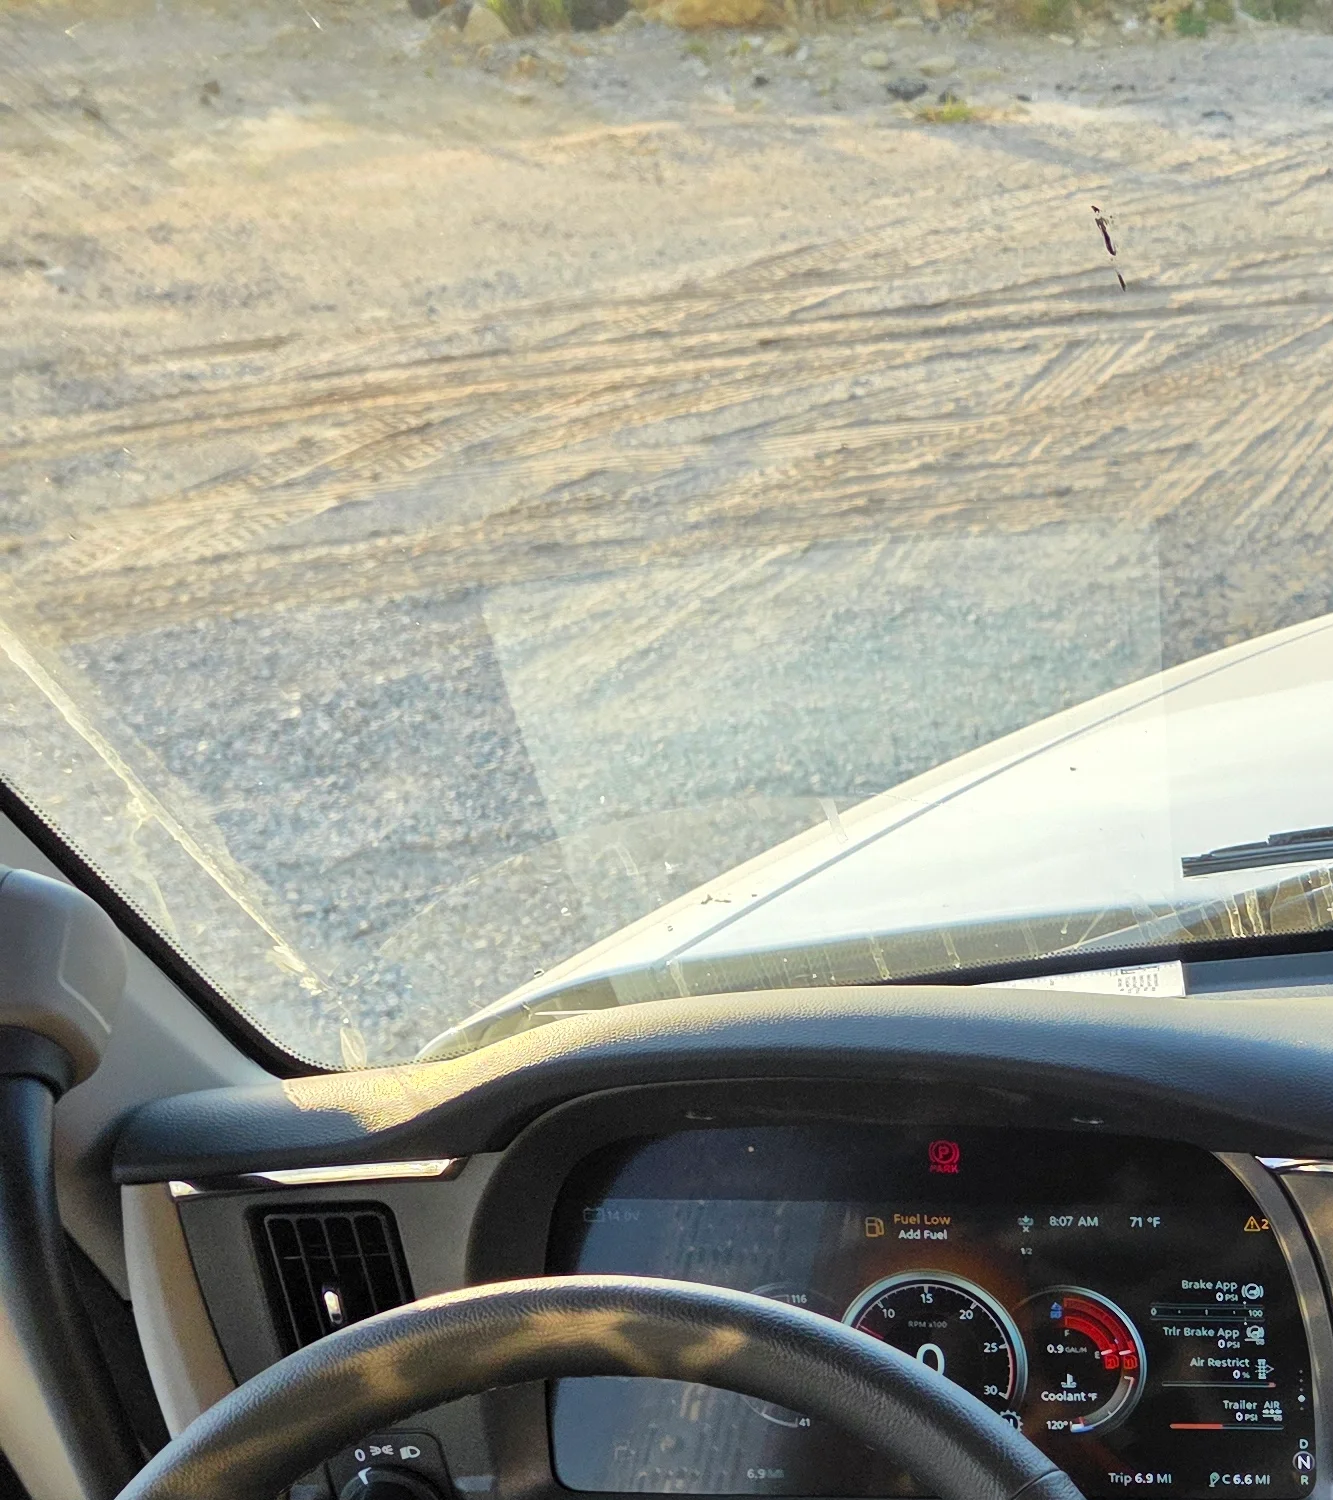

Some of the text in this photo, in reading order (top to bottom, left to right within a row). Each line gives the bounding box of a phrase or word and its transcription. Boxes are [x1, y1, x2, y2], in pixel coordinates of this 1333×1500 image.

[929, 1164, 959, 1174] PARK
[893, 1213, 951, 1225] Fuel Low
[1049, 1215, 1099, 1227] 8:07 AM
[1129, 1216, 1143, 1228] 71
[1261, 1218, 1269, 1230] 2
[898, 1229, 948, 1240] Add Fuel
[1181, 1279, 1238, 1292] Brake App
[920, 1293, 934, 1304] 15
[1215, 1292, 1239, 1302] 0 PSI
[882, 1308, 896, 1319] 10
[959, 1309, 974, 1320] 20
[1248, 1309, 1264, 1318] 100
[907, 1320, 927, 1328] RPM
[1163, 1326, 1240, 1340] Trlr Brake App
[983, 1342, 998, 1353] 25
[1046, 1343, 1065, 1354] 0.9
[1217, 1339, 1241, 1349] 0 PSI
[1189, 1357, 1250, 1368] Air Restrict
[1232, 1369, 1241, 1379] 0
[983, 1385, 998, 1395] 30
[1041, 1390, 1087, 1402] Coolant
[1222, 1400, 1258, 1410] Trailer
[1263, 1400, 1281, 1409] AIR
[1235, 1411, 1259, 1421] 0 PSI
[798, 1418, 811, 1427] 41
[1299, 1438, 1309, 1450] D
[1297, 1455, 1311, 1470] N
[1108, 1472, 1172, 1487] Trip 6.9 MI
[1221, 1474, 1271, 1485] C 6.6 MI
[1300, 1475, 1309, 1486] R
